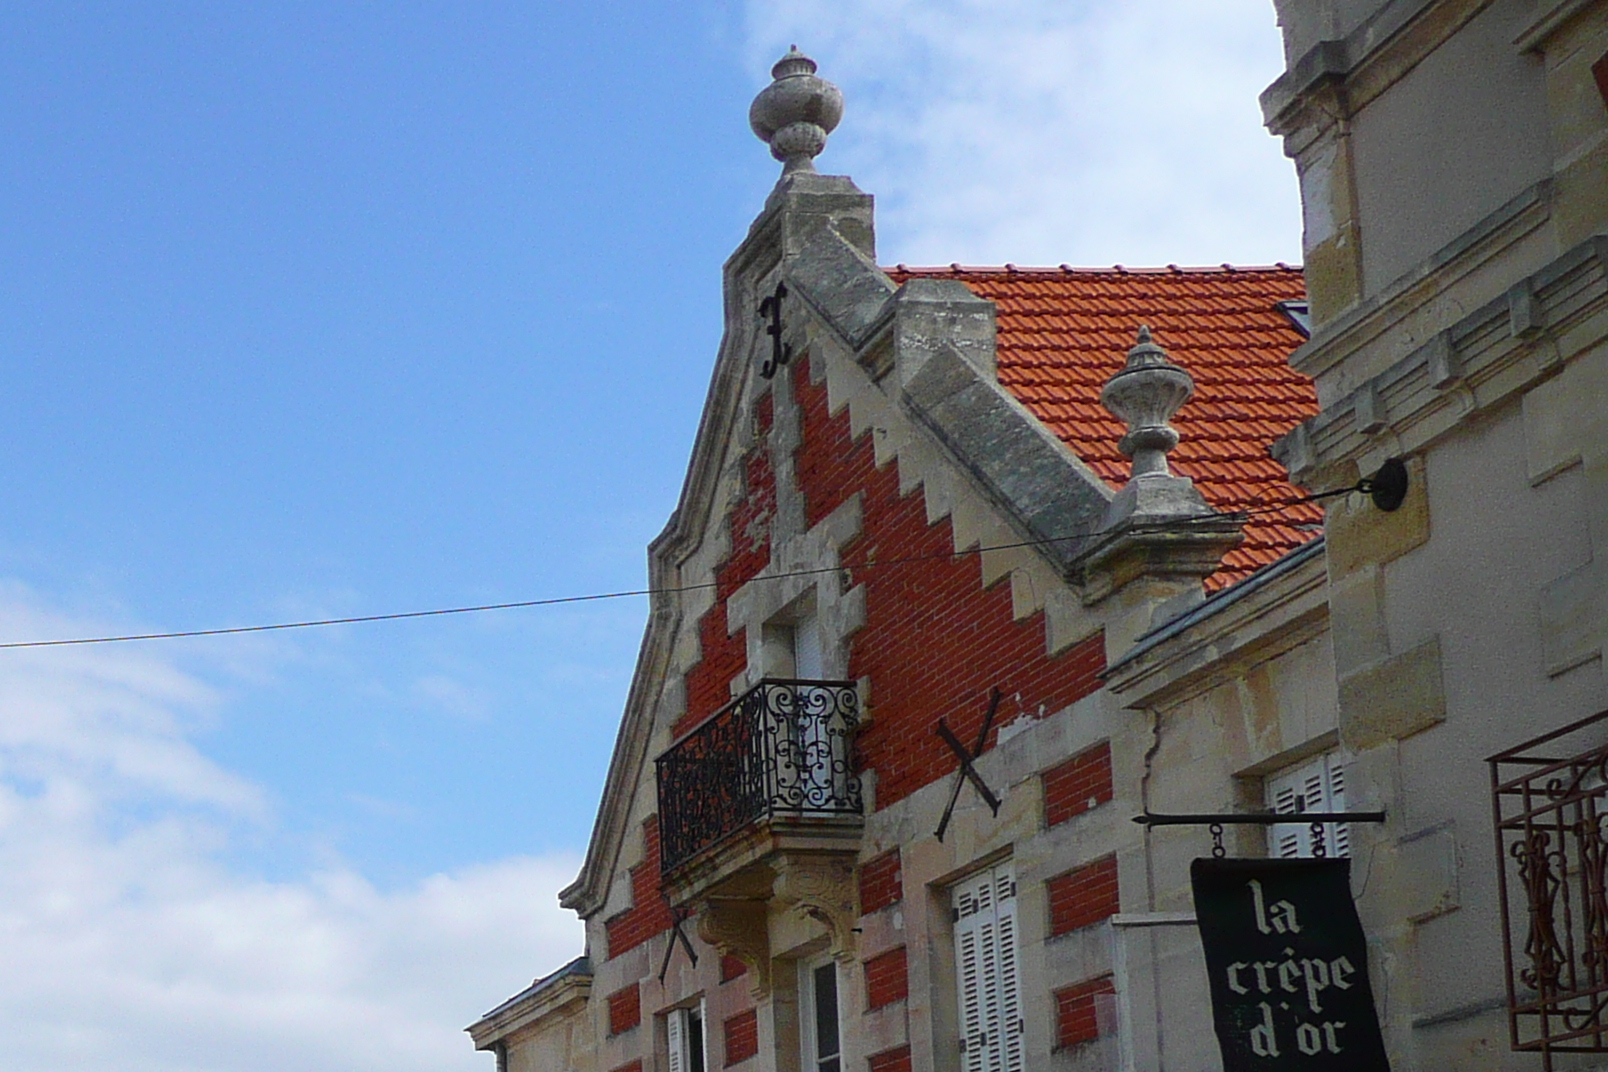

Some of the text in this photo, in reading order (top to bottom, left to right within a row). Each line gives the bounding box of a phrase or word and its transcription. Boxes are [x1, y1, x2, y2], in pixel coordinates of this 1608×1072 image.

[1246, 878, 1303, 935] la
[1226, 947, 1355, 1014] crêpe
[1250, 1001, 1347, 1058] d'or
